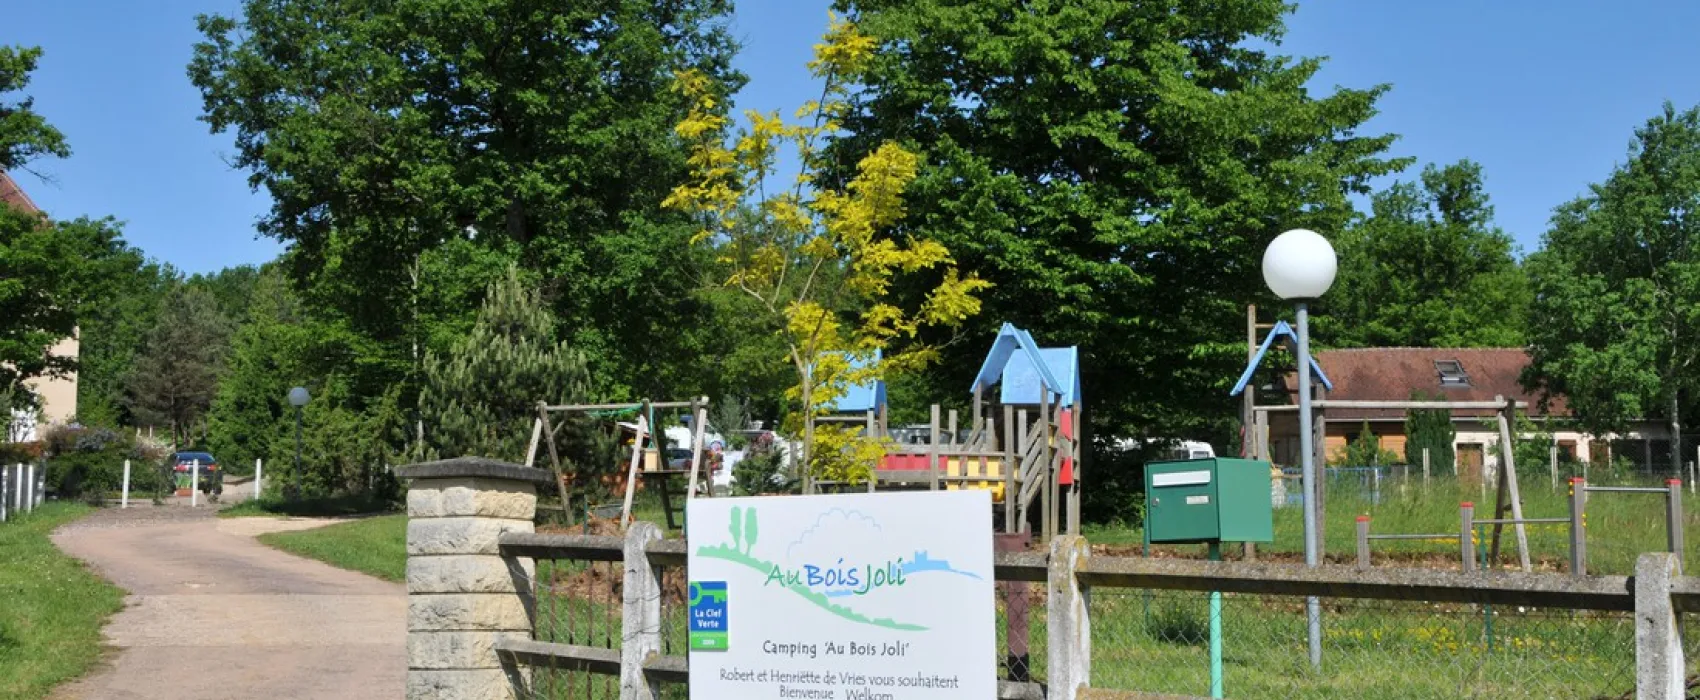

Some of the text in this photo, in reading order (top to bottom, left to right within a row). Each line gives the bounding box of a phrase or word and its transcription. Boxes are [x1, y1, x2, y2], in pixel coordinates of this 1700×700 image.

[764, 557, 906, 595] Au Bois Joli
[695, 608, 722, 618] La Clef
[697, 619, 719, 628] Verte
[763, 640, 817, 659] Camping
[849, 641, 876, 656] Bois
[719, 667, 959, 689] Robert et Henriëtte de Vries vous souhaitent
[779, 685, 894, 700] Bienvenue Welkom
